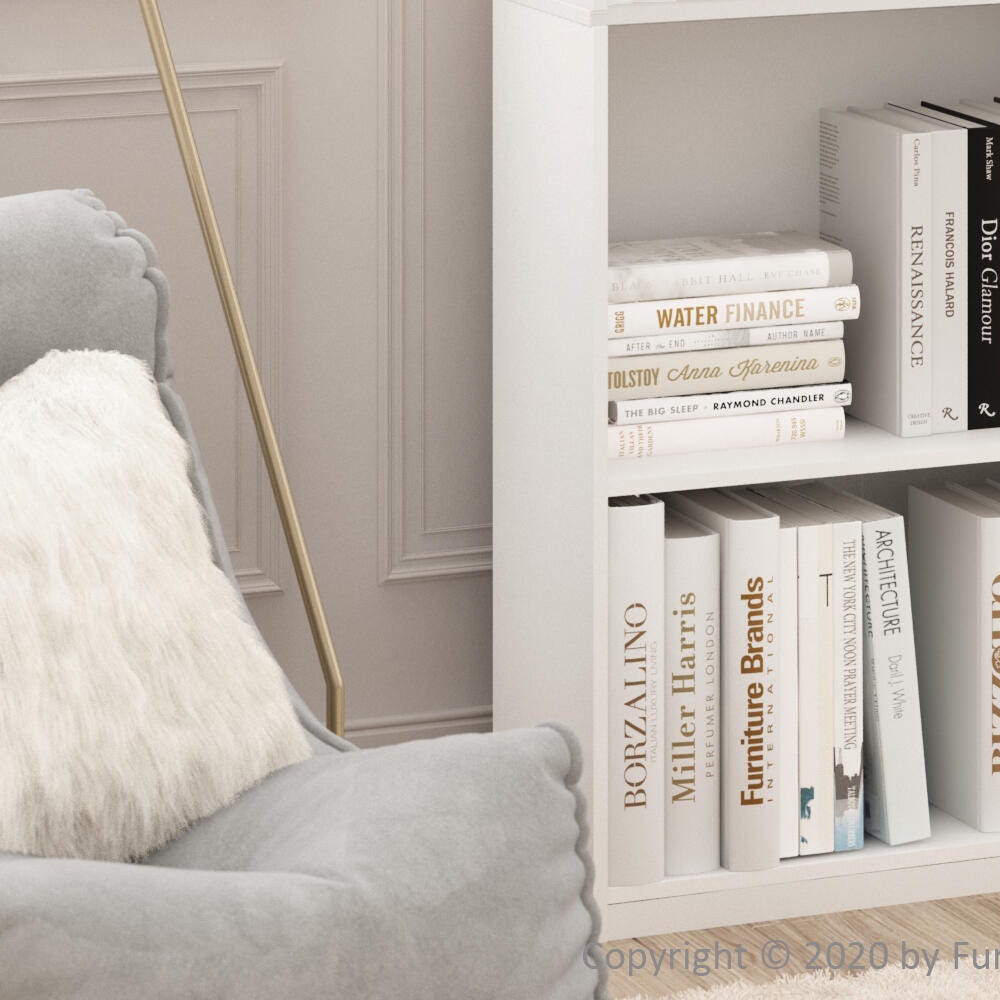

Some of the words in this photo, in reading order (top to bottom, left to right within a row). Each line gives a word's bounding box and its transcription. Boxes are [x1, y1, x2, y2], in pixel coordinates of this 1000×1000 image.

[985, 137, 993, 157] Mark
[985, 159, 993, 181] Shaw
[945, 211, 954, 268] FRANCOIS
[981, 219, 998, 261] Dior
[657, 305, 718, 329] WATER
[726, 298, 806, 324] FINANCE
[911, 224, 923, 368] RENAISSANCE
[945, 272, 954, 318] HALARD
[981, 267, 998, 344] Glamour
[614, 310, 625, 333] GRIGG
[767, 330, 798, 341] AUTHOR
[804, 328, 825, 338] NAME
[626, 342, 651, 352] AFTER
[669, 339, 685, 349] END
[608, 368, 659, 389] TOLSTOY
[667, 364, 723, 382] Anna
[729, 356, 819, 381] Karenina
[625, 408, 644, 418] THE
[648, 406, 666, 416] BIG
[670, 404, 698, 415] SLEEP
[713, 399, 766, 411] RAYMOND
[771, 393, 825, 407] CHANDLER
[843, 540, 856, 559] THE
[843, 561, 856, 582] NEW
[843, 585, 856, 611] YORK
[671, 591, 696, 695] Harris
[740, 576, 764, 675] Brands
[843, 613, 856, 635] CITY
[875, 529, 902, 637] ARCHITECTURE
[890, 688, 906, 720] White
[706, 611, 715, 686] LONDON
[843, 637, 856, 666] NOON
[624, 602, 648, 809] BORZALINO
[844, 668, 857, 704] PRAYER
[706, 694, 714, 778] PERFUMER
[740, 682, 764, 806] Furniture
[844, 706, 857, 750] MEETING
[671, 704, 696, 804] Miller
